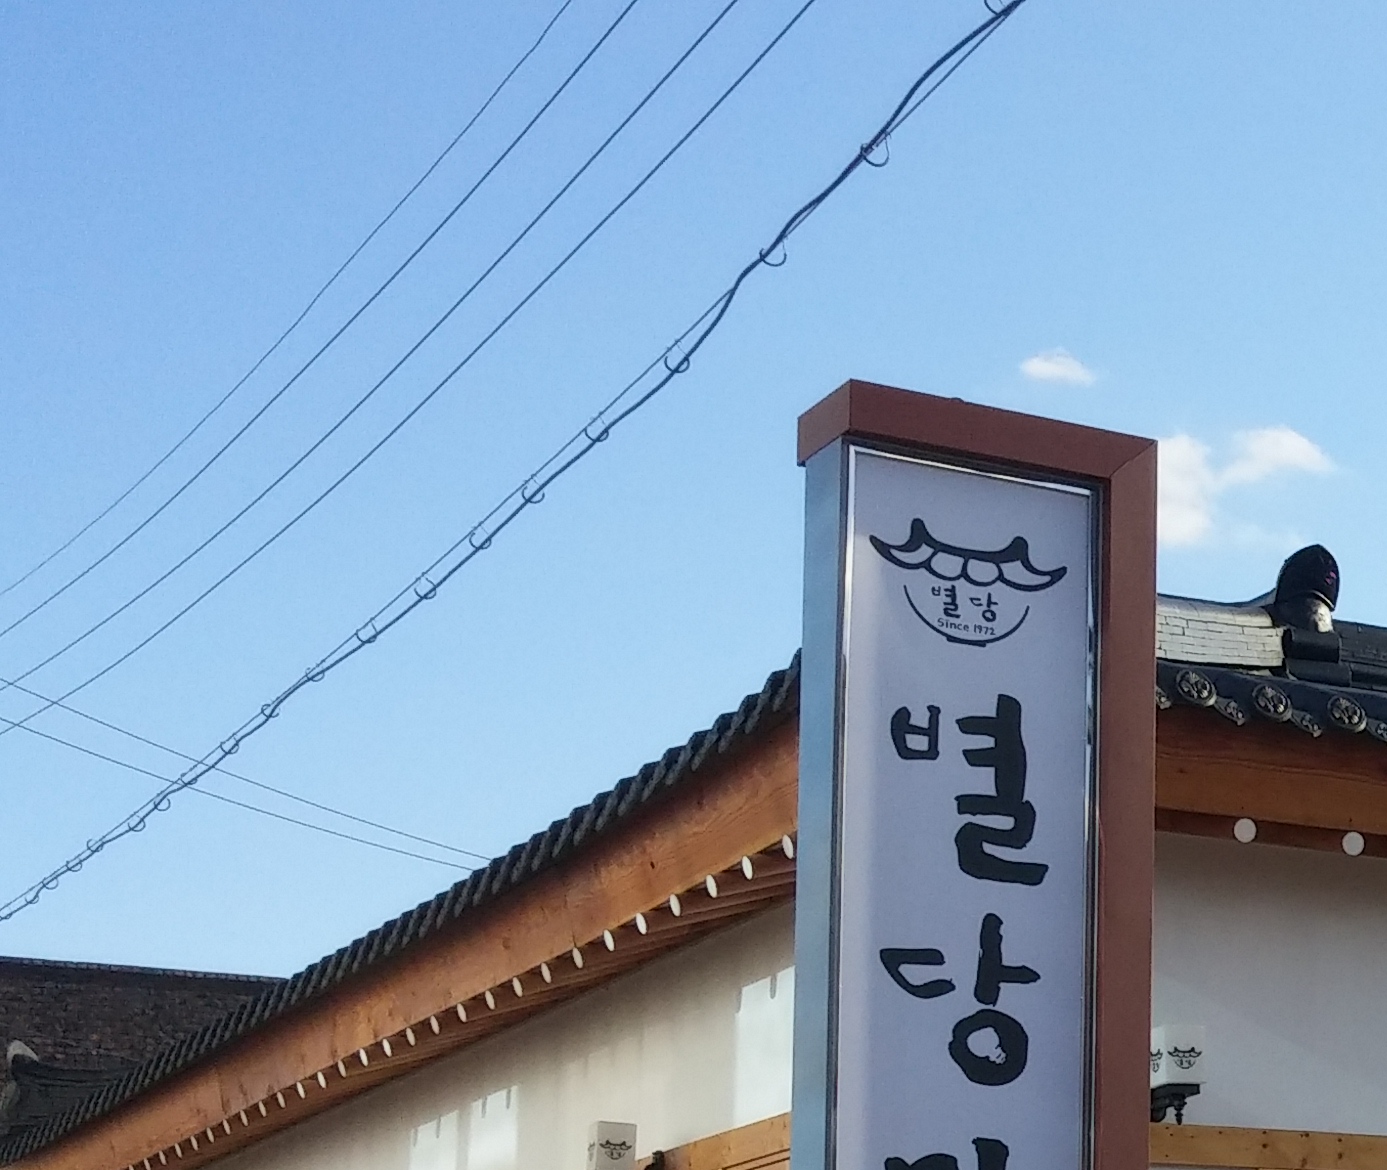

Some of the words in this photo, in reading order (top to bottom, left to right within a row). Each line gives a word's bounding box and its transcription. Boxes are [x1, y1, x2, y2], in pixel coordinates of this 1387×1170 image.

[931, 584, 999, 623] 별당
[937, 617, 970, 632] Since
[973, 623, 997, 636] 1972
